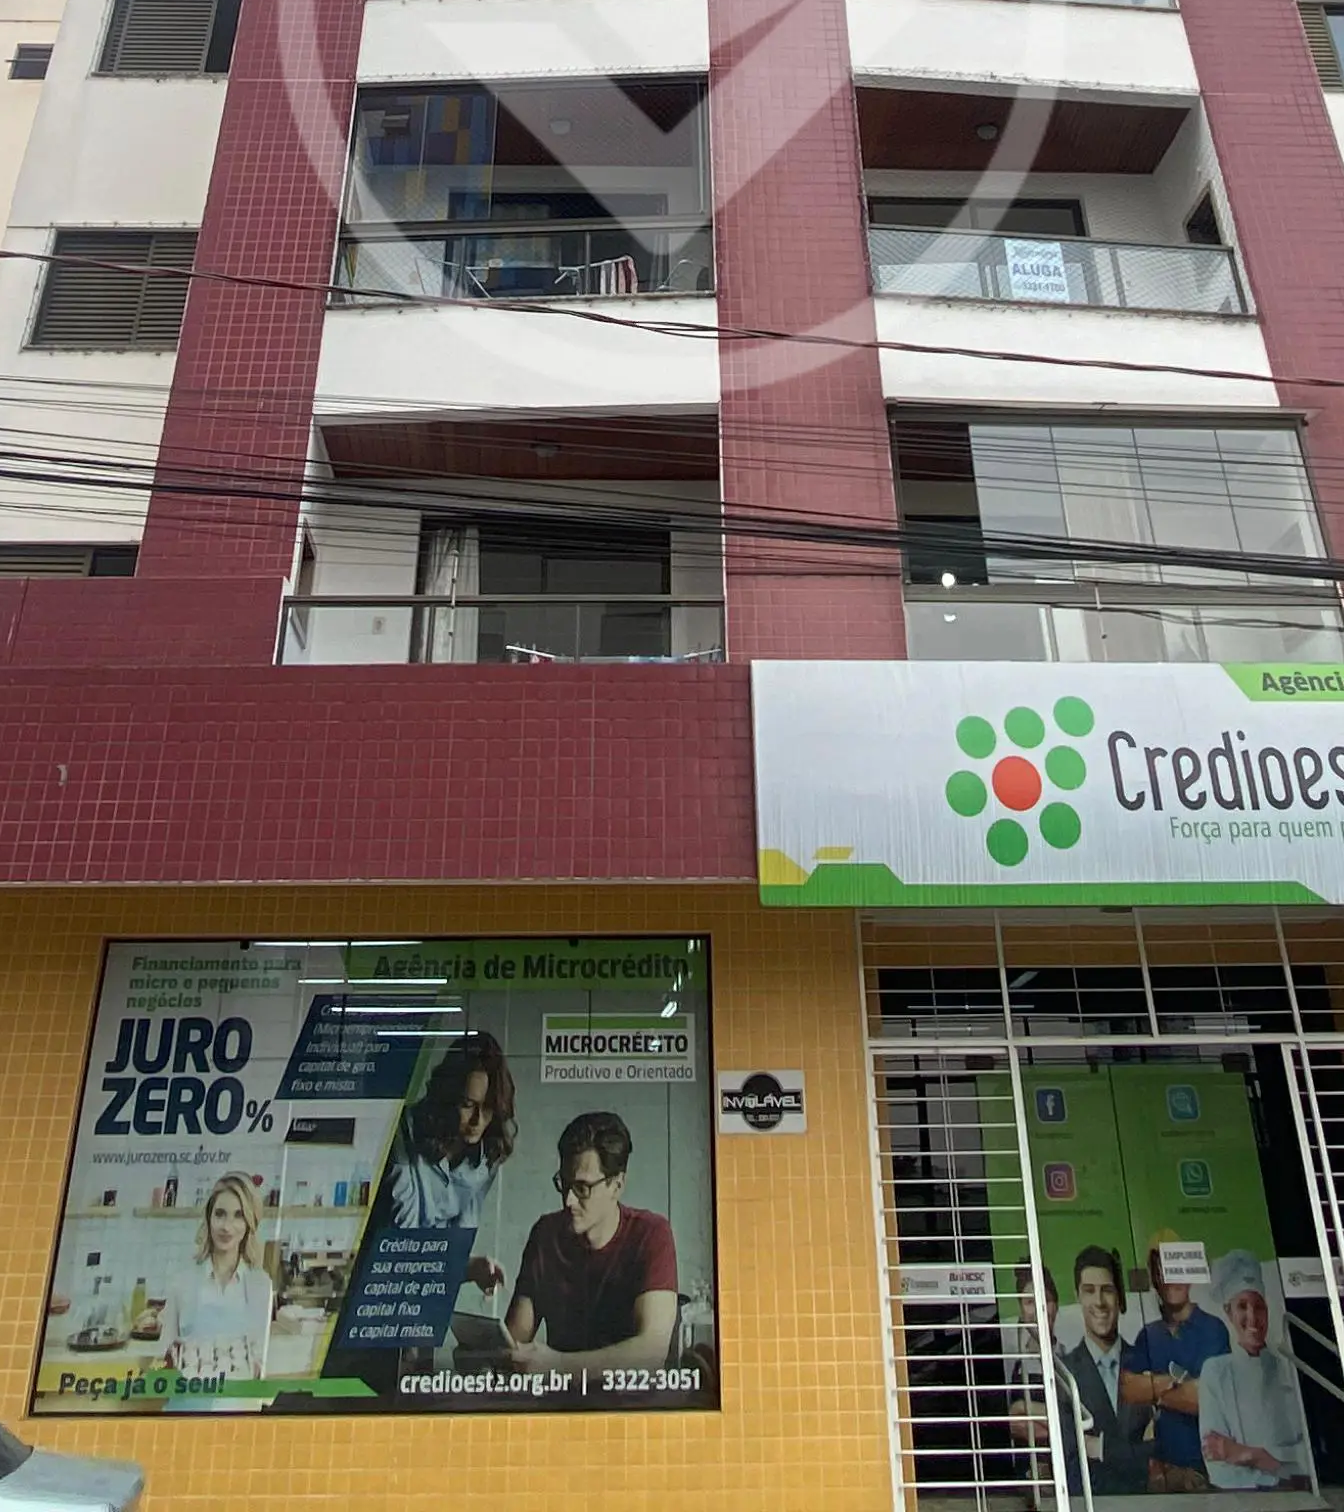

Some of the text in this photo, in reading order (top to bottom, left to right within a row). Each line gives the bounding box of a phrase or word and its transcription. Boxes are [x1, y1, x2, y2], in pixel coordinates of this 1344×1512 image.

[1012, 264, 1062, 277] ALUGA
[1170, 817, 1222, 844] Força
[1229, 820, 1272, 843] para
[1279, 821, 1334, 843] quem
[132, 956, 258, 972] Financiamento
[373, 953, 689, 982] Agência de Microcrédito
[129, 975, 280, 994] micro e pequenos
[126, 992, 202, 1012] negócios
[104, 1016, 253, 1074] JURO
[545, 1030, 688, 1054] MICROCRÉDITO
[545, 1063, 693, 1080] Produtivo e Orientado
[379, 1238, 448, 1254] Crédito para
[370, 1261, 393, 1274] sua
[363, 1280, 403, 1296] capital
[404, 1280, 420, 1295] de
[356, 1301, 421, 1318] capital fixo
[349, 1326, 358, 1339] e
[359, 1324, 399, 1339] capital
[58, 1368, 226, 1401] Peça já o seu!
[400, 1367, 701, 1397] credioeste.org.br 3322-3051
